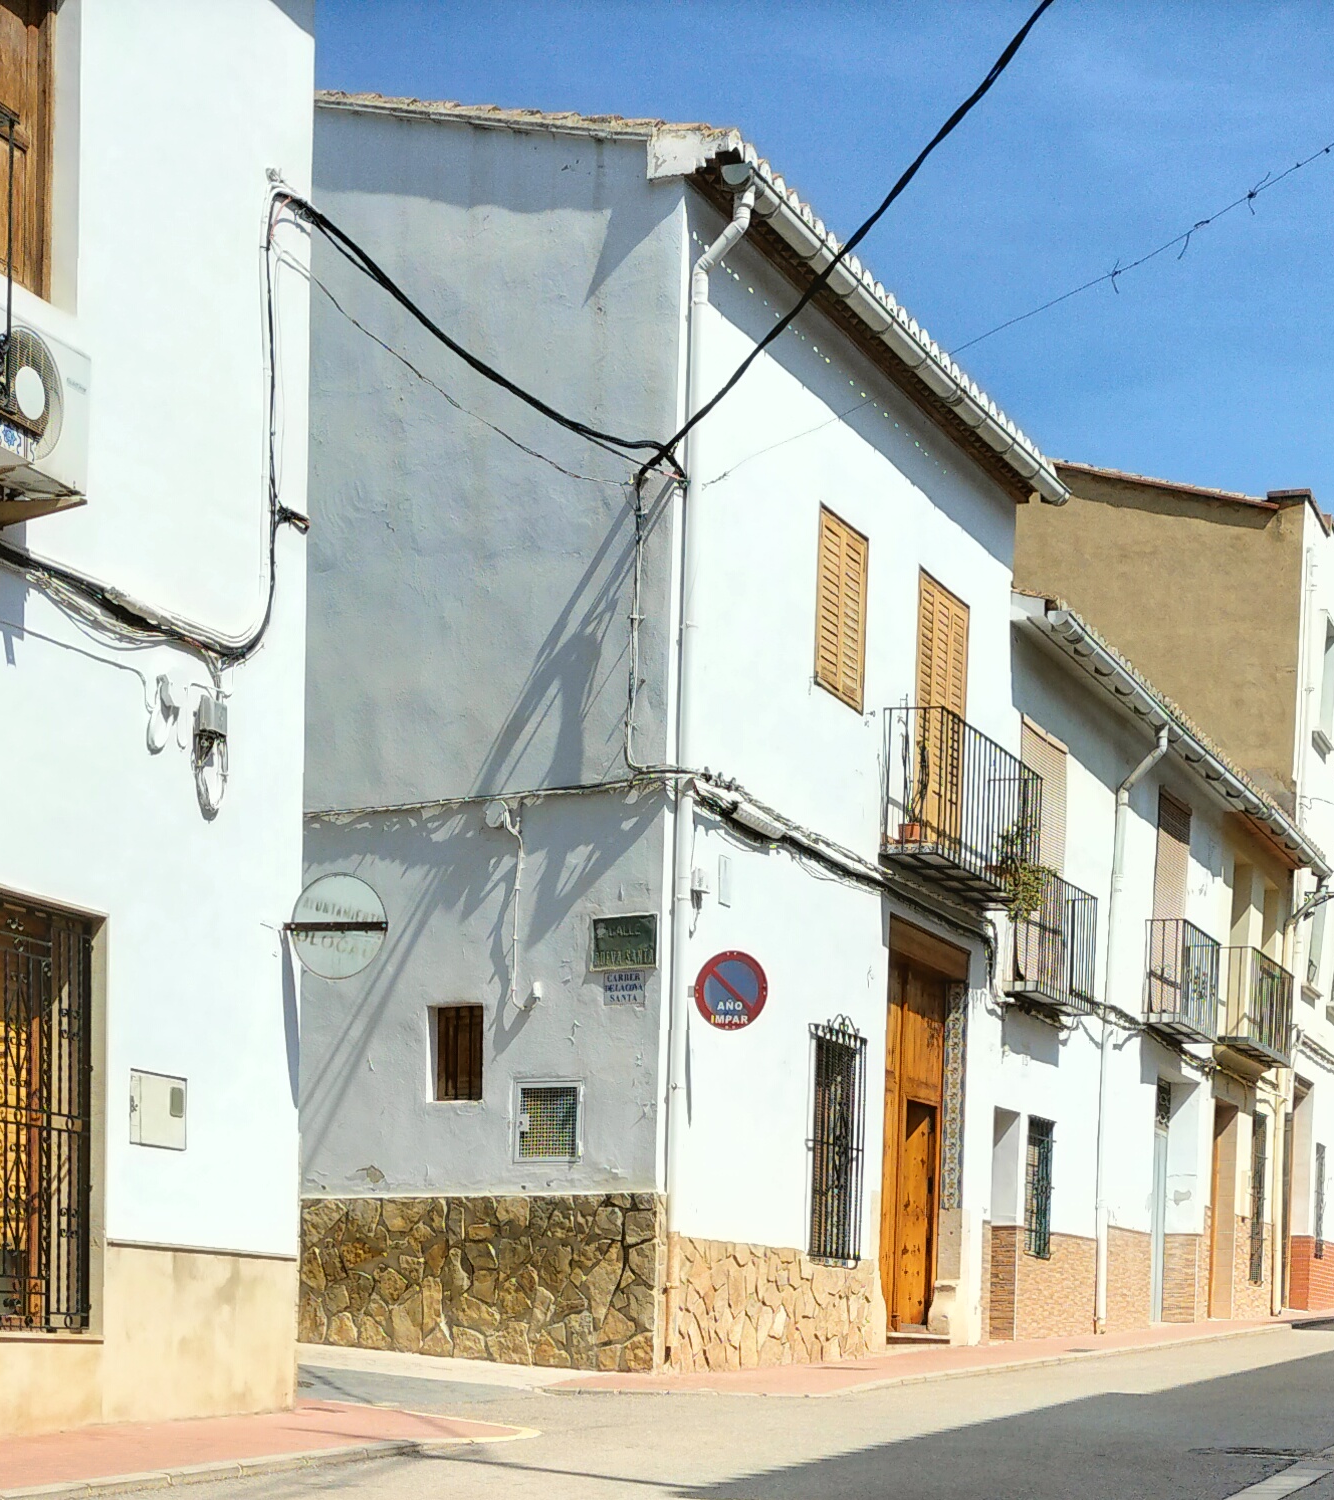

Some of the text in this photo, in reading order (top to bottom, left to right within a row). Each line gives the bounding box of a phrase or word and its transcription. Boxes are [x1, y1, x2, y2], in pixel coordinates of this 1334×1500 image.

[607, 973, 641, 982] CARRER
[610, 994, 638, 1003] SANTA
[717, 998, 743, 1011] AÑO
[710, 1014, 749, 1025] IMPAR
